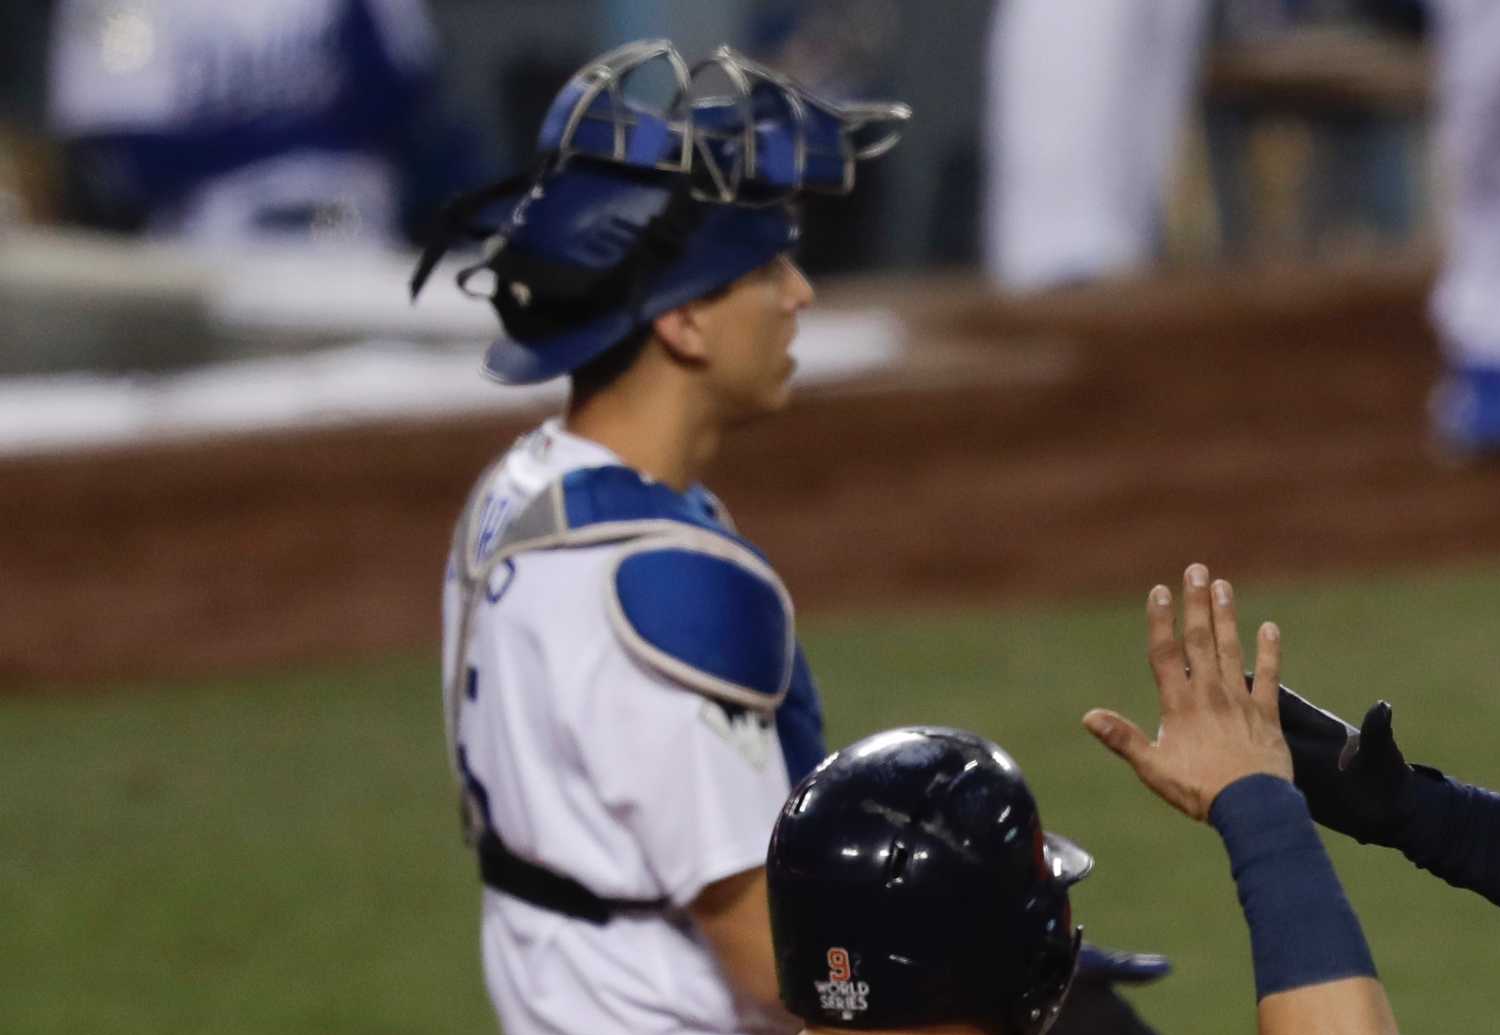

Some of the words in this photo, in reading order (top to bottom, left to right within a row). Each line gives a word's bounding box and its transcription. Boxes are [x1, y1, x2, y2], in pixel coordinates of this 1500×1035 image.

[826, 947, 851, 982] 9
[814, 980, 870, 996] WORLD
[820, 995, 869, 1011] SERIES
